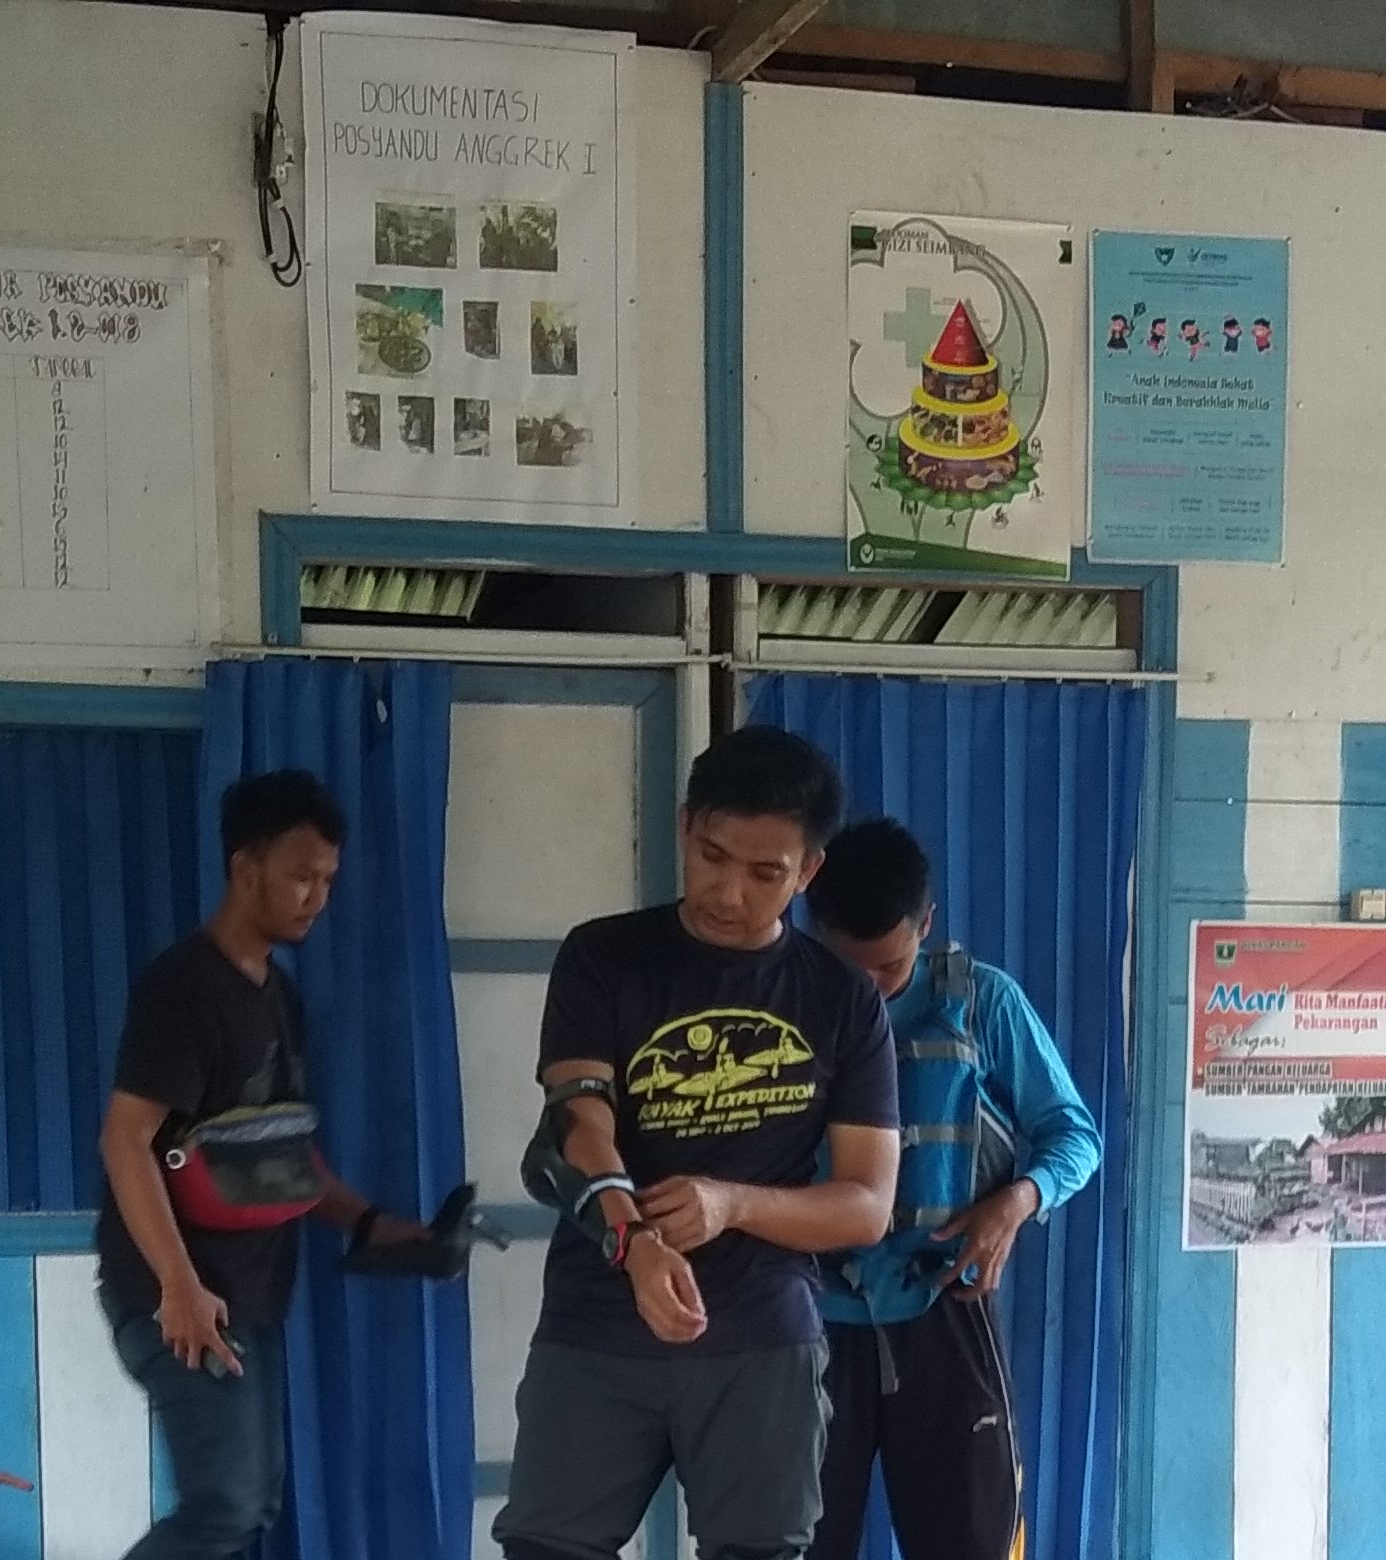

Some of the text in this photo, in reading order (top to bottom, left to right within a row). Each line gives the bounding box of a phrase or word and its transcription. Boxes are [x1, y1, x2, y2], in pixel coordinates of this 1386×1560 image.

[360, 80, 540, 124] DOKUMENTASI
[332, 122, 439, 163] POSYANDU
[454, 132, 571, 172] ANGGREK
[38, 271, 169, 310] POSYANDU
[1205, 982, 1288, 1014] Mari
[1294, 993, 1322, 1010] Kita
[1294, 1015, 1378, 1035] Pekarangan
